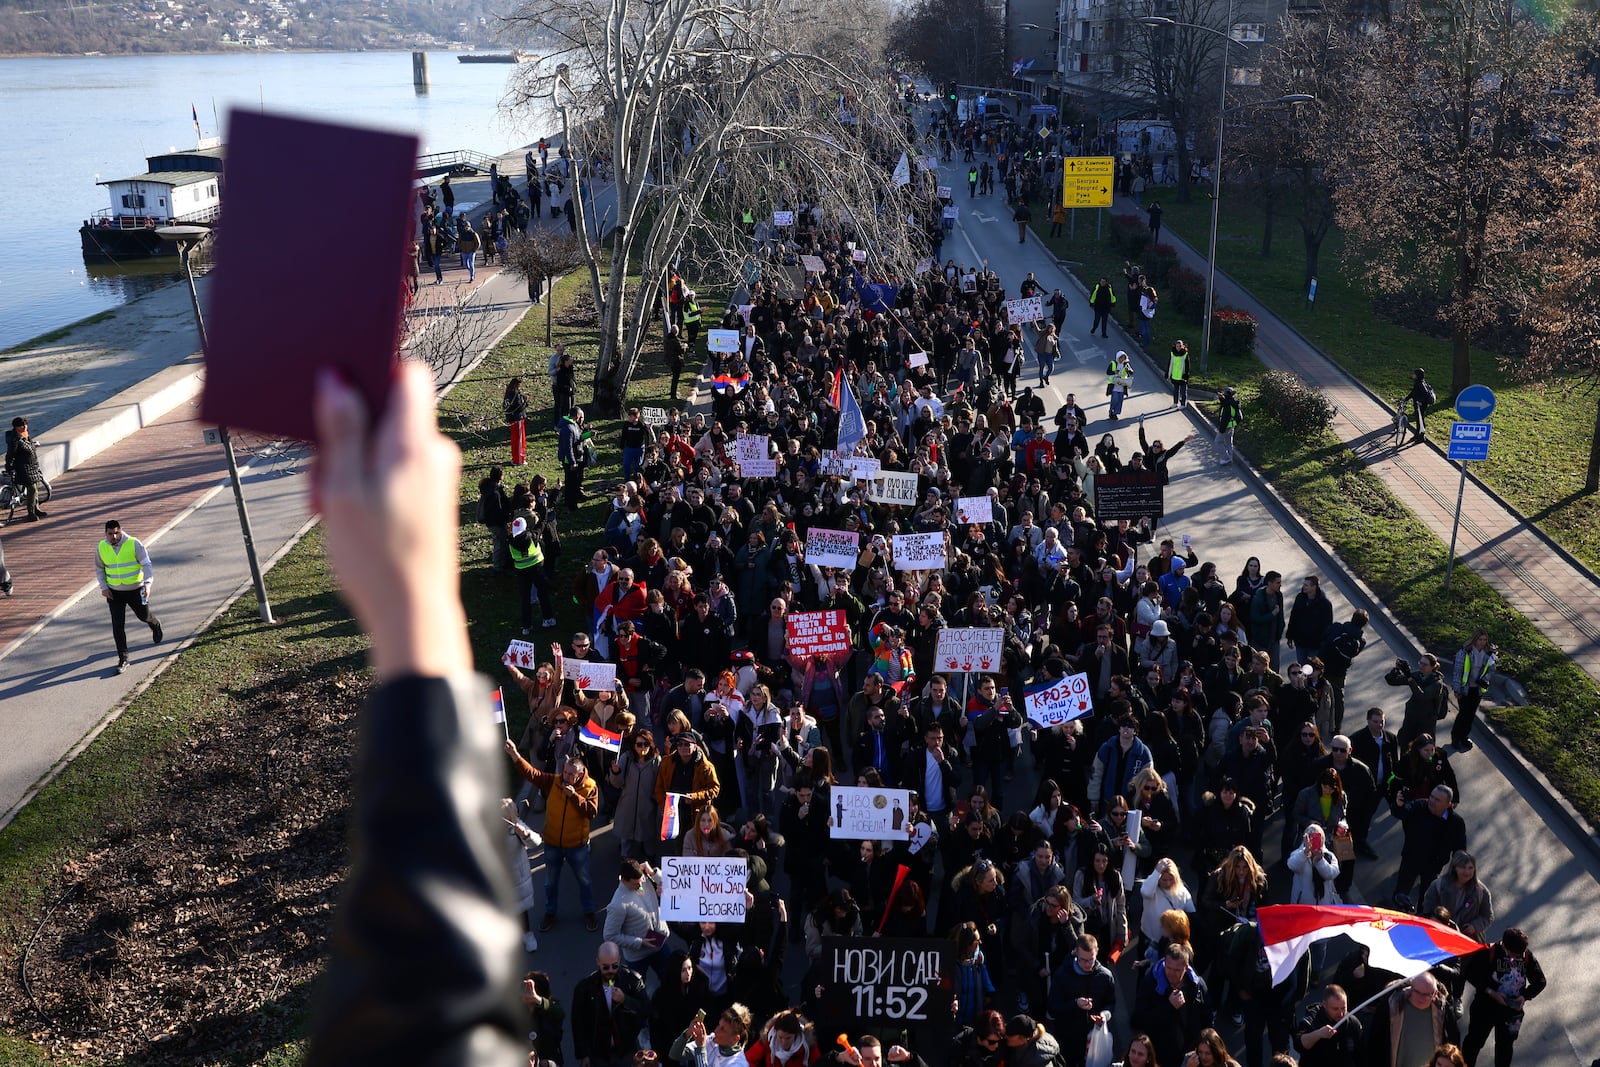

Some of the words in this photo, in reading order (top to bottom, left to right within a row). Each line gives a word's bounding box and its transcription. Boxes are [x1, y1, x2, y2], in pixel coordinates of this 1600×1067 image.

[1008, 298, 1041, 309] БЕОГРАД
[1021, 306, 1029, 314] УЗ
[1010, 315, 1025, 323] НОВИ
[1027, 312, 1042, 321] САД
[643, 407, 663, 417] STIGLI
[888, 478, 901, 488] OVO
[902, 479, 916, 490] NIJE
[825, 611, 837, 619] СЕ
[826, 618, 837, 626] СЕ
[835, 632, 845, 640] КО
[939, 630, 1003, 642] СНОСИЋЕТЕ
[791, 647, 806, 655] ОВО
[808, 642, 847, 653] ПРЕСПАВА
[938, 641, 1002, 655] ОДГОВОРНОСТ
[1033, 685, 1071, 709] КРОЗ
[850, 810, 870, 819] ДАЈ
[852, 818, 886, 832] НОБЕЛА!
[724, 864, 746, 876] SVAKI
[670, 877, 691, 889] DAN
[725, 876, 744, 894] SAD
[699, 896, 745, 916] BEOGRAD
[833, 948, 895, 985] НОВИ
[851, 985, 928, 1020] 11:52
